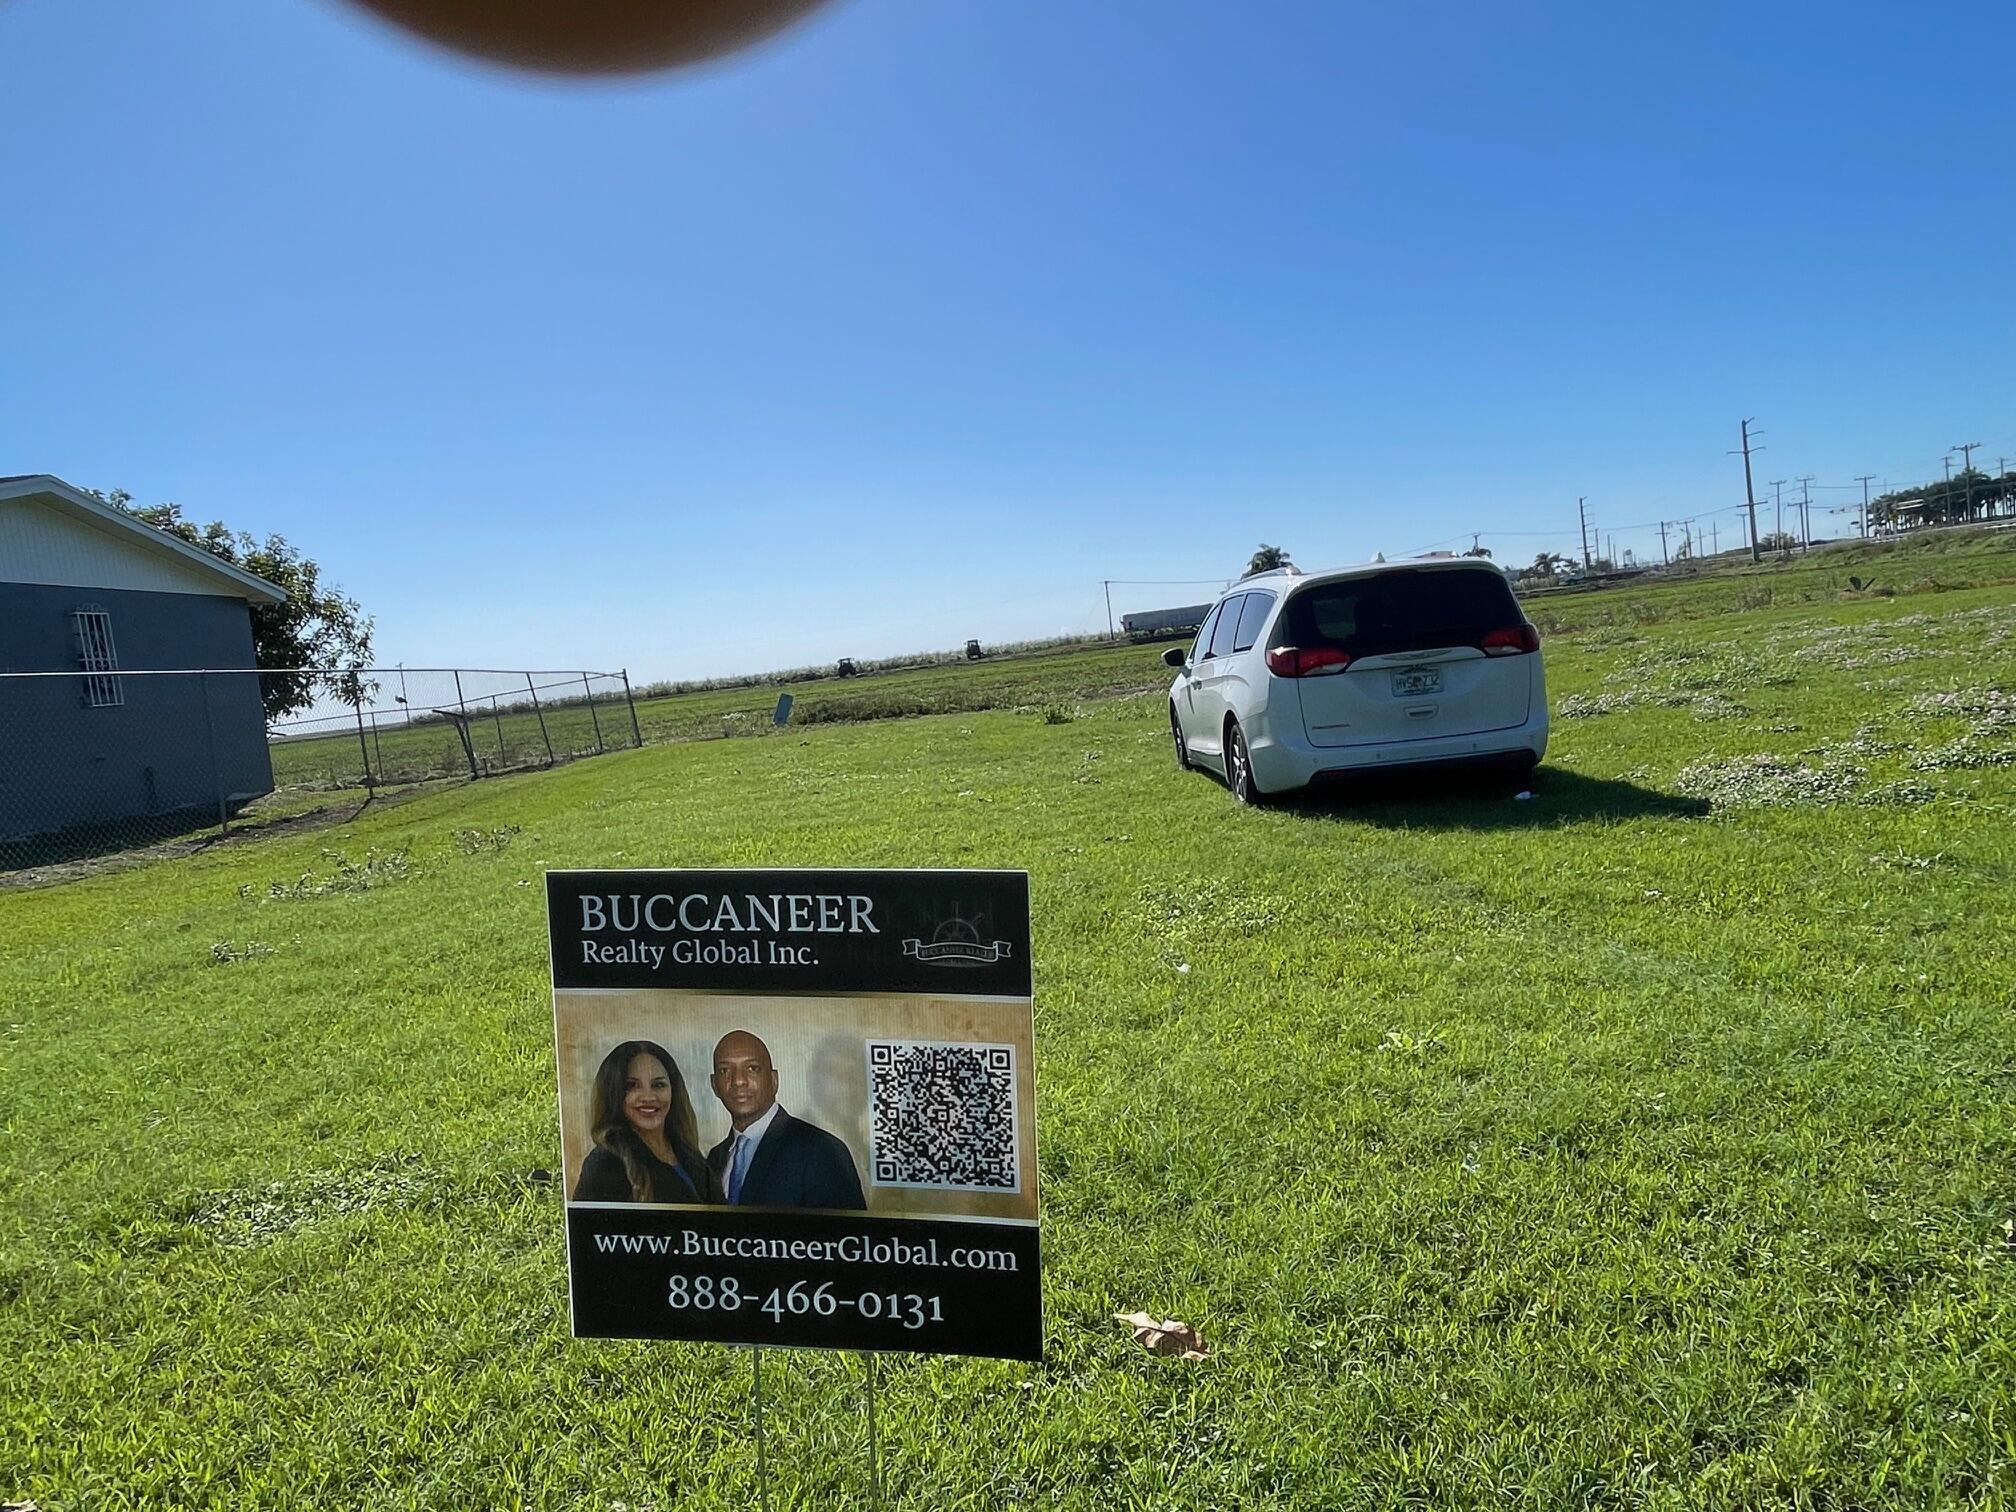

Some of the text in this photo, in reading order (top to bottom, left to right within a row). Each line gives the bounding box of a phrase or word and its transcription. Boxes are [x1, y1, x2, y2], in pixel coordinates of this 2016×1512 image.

[578, 893, 881, 934] BUCCANEER
[581, 938, 820, 970] Realty Global Inc.
[593, 1230, 1019, 1272] www.BuccaneerGlobal.com
[668, 1274, 945, 1329] 888-466-0131
